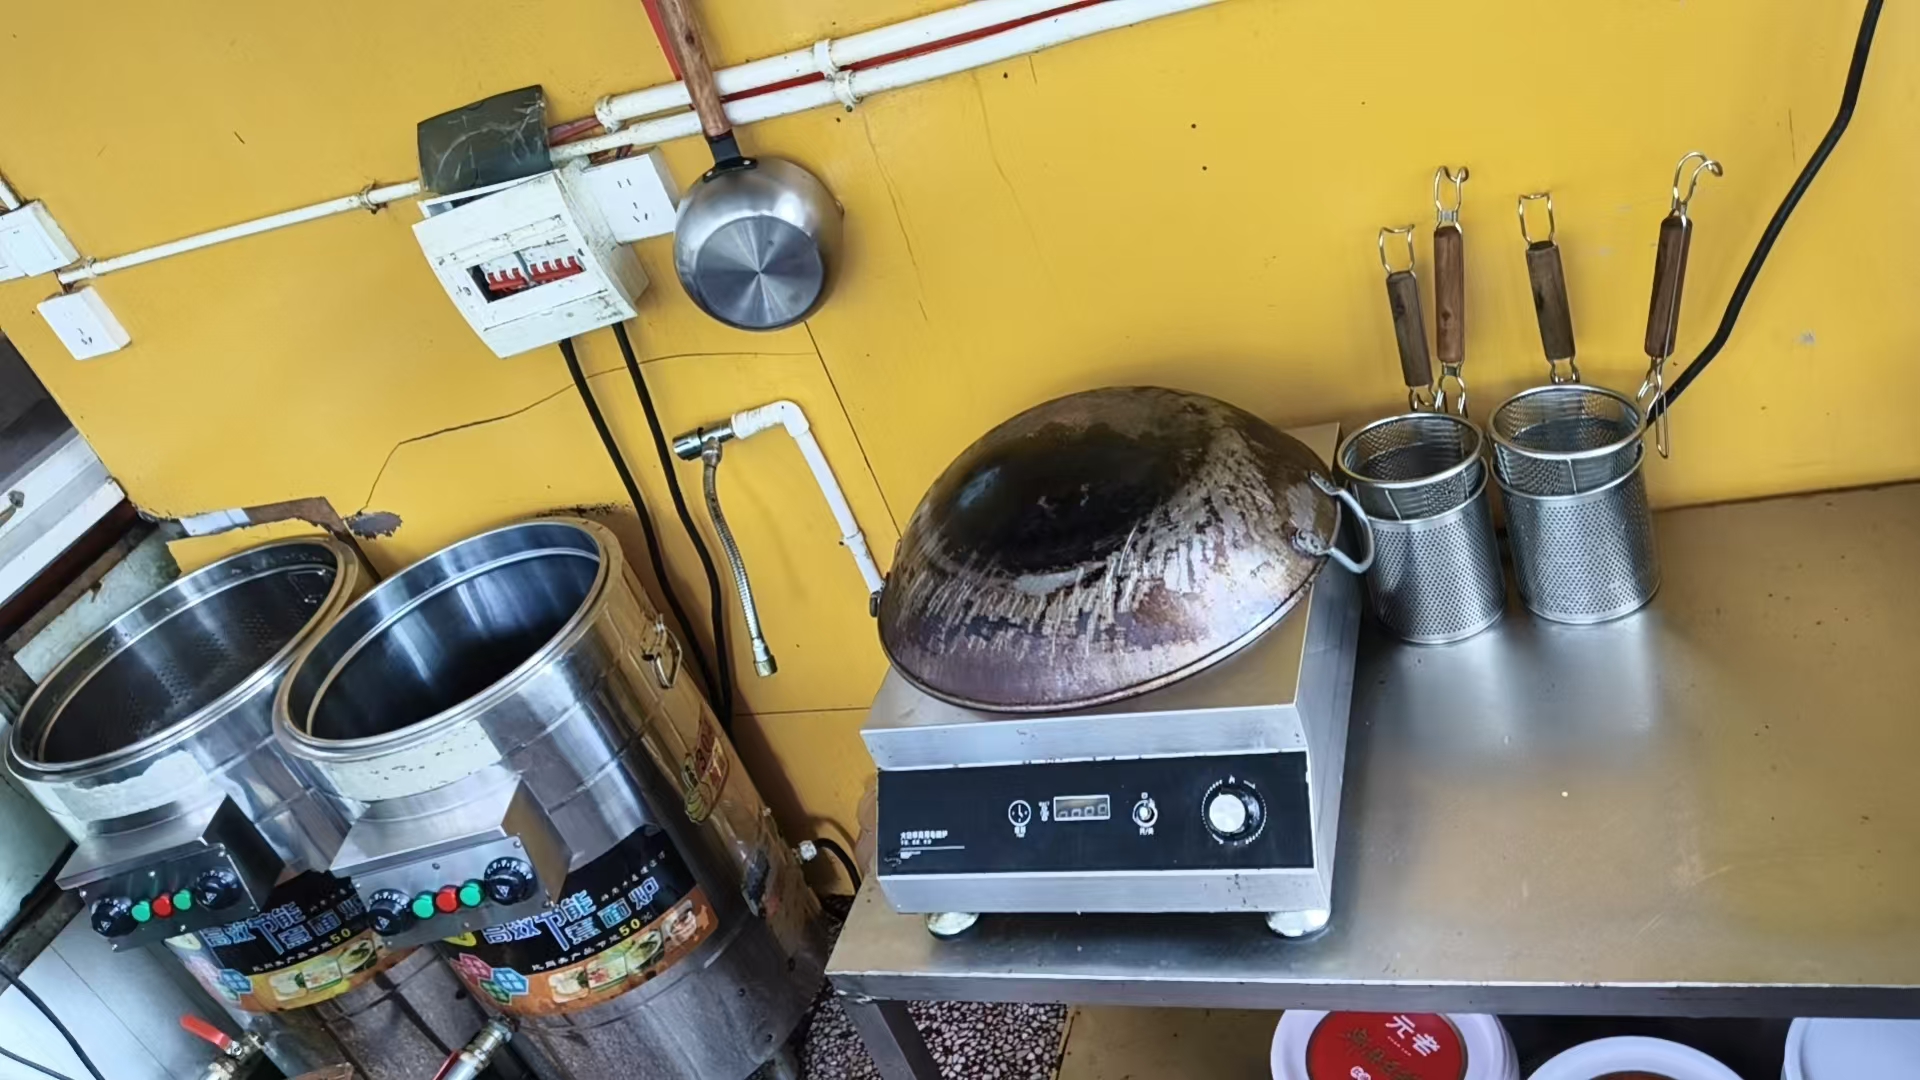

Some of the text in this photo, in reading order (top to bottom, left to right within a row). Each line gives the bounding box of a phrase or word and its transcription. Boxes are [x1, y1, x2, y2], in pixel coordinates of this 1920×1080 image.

[482, 889, 597, 951] 高效节能
[564, 876, 660, 945] 煮面炉
[1385, 1014, 1441, 1057] 元老
